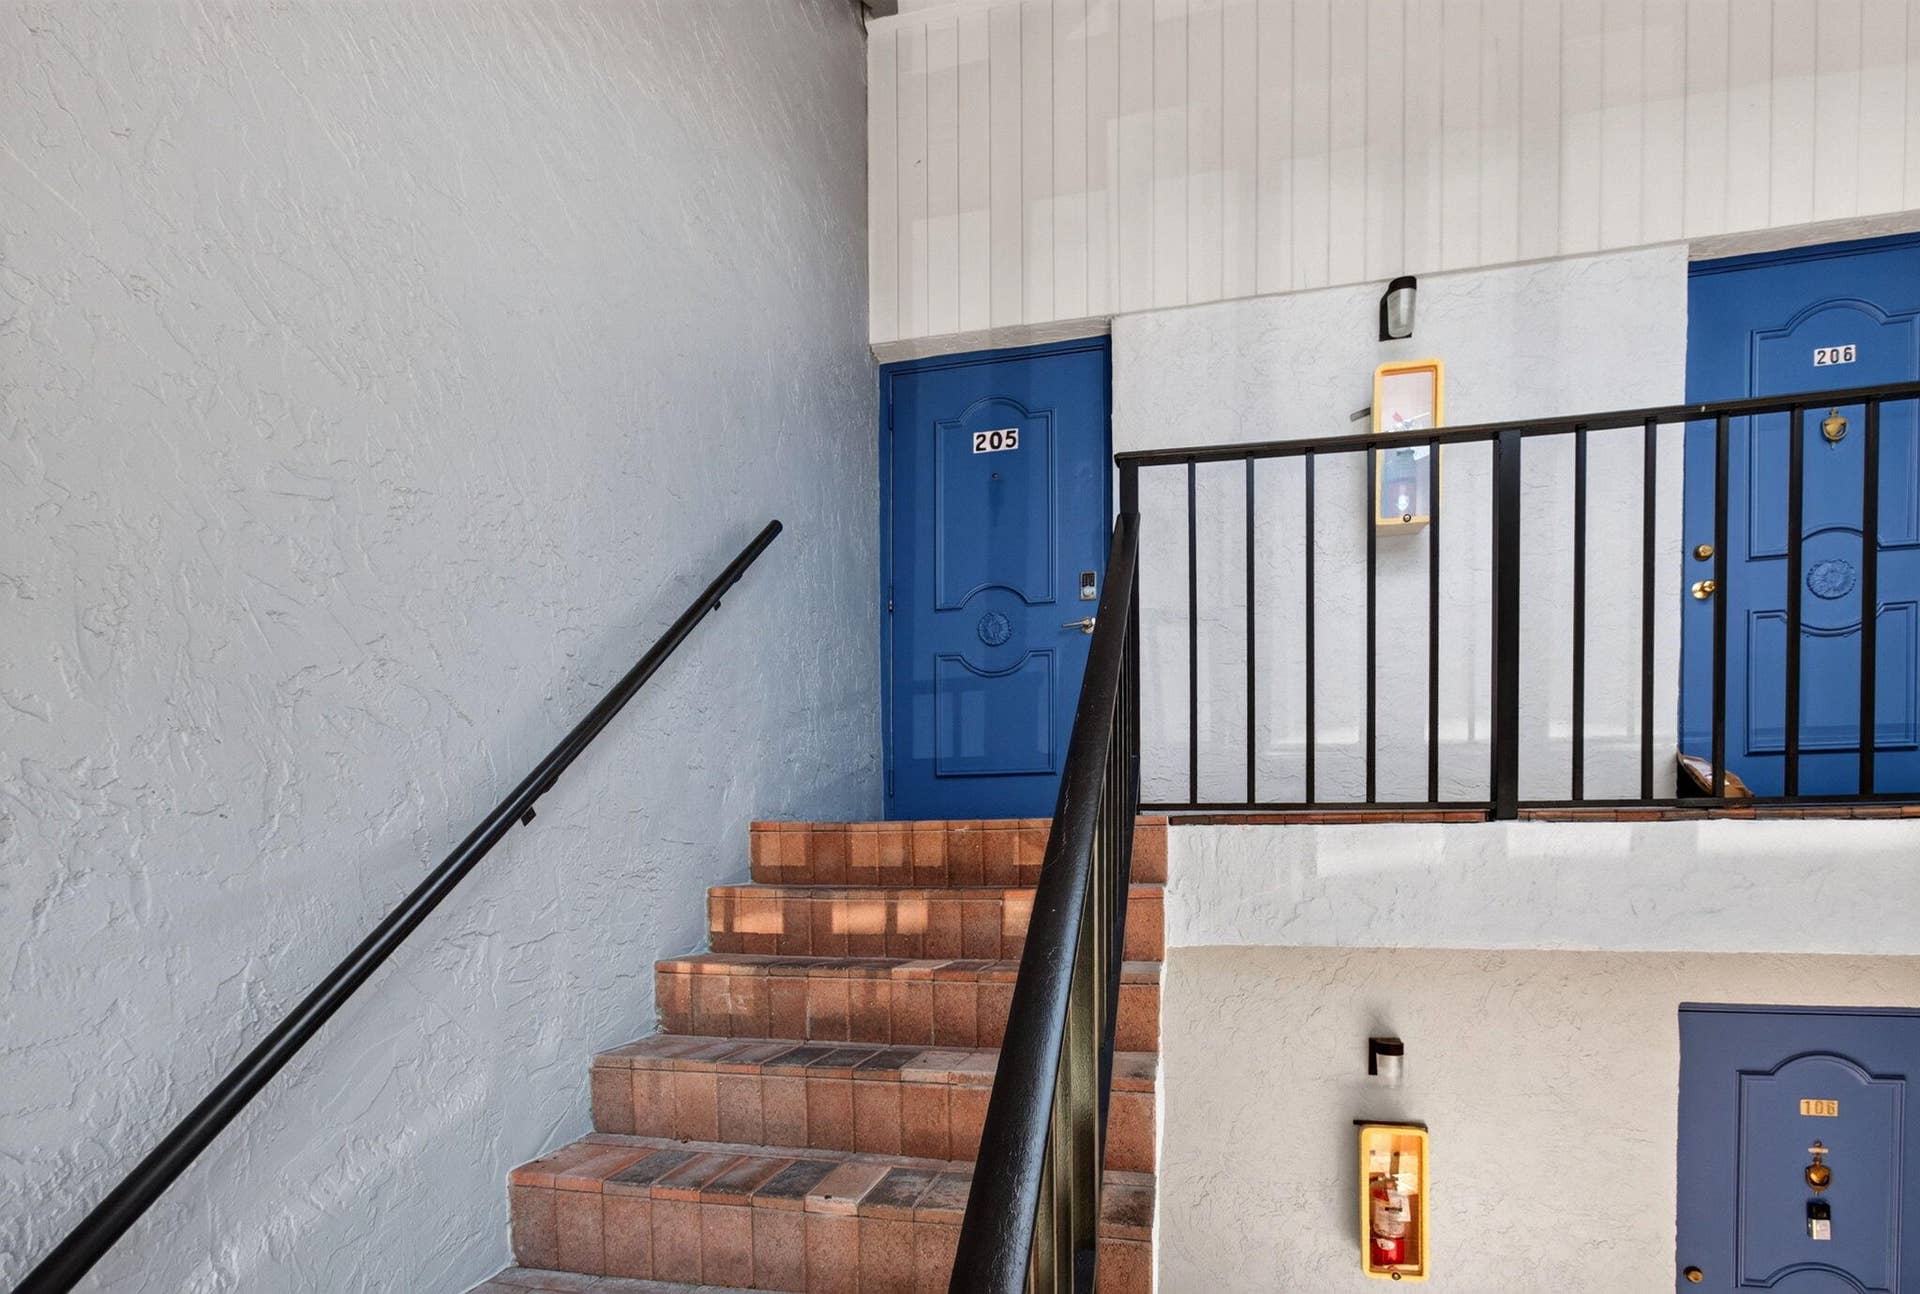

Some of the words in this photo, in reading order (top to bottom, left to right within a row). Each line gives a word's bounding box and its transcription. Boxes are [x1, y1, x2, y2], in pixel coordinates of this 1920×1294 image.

[1816, 346, 1853, 365] 206
[975, 430, 1017, 452] 205
[1804, 1100, 1836, 1115] 106
